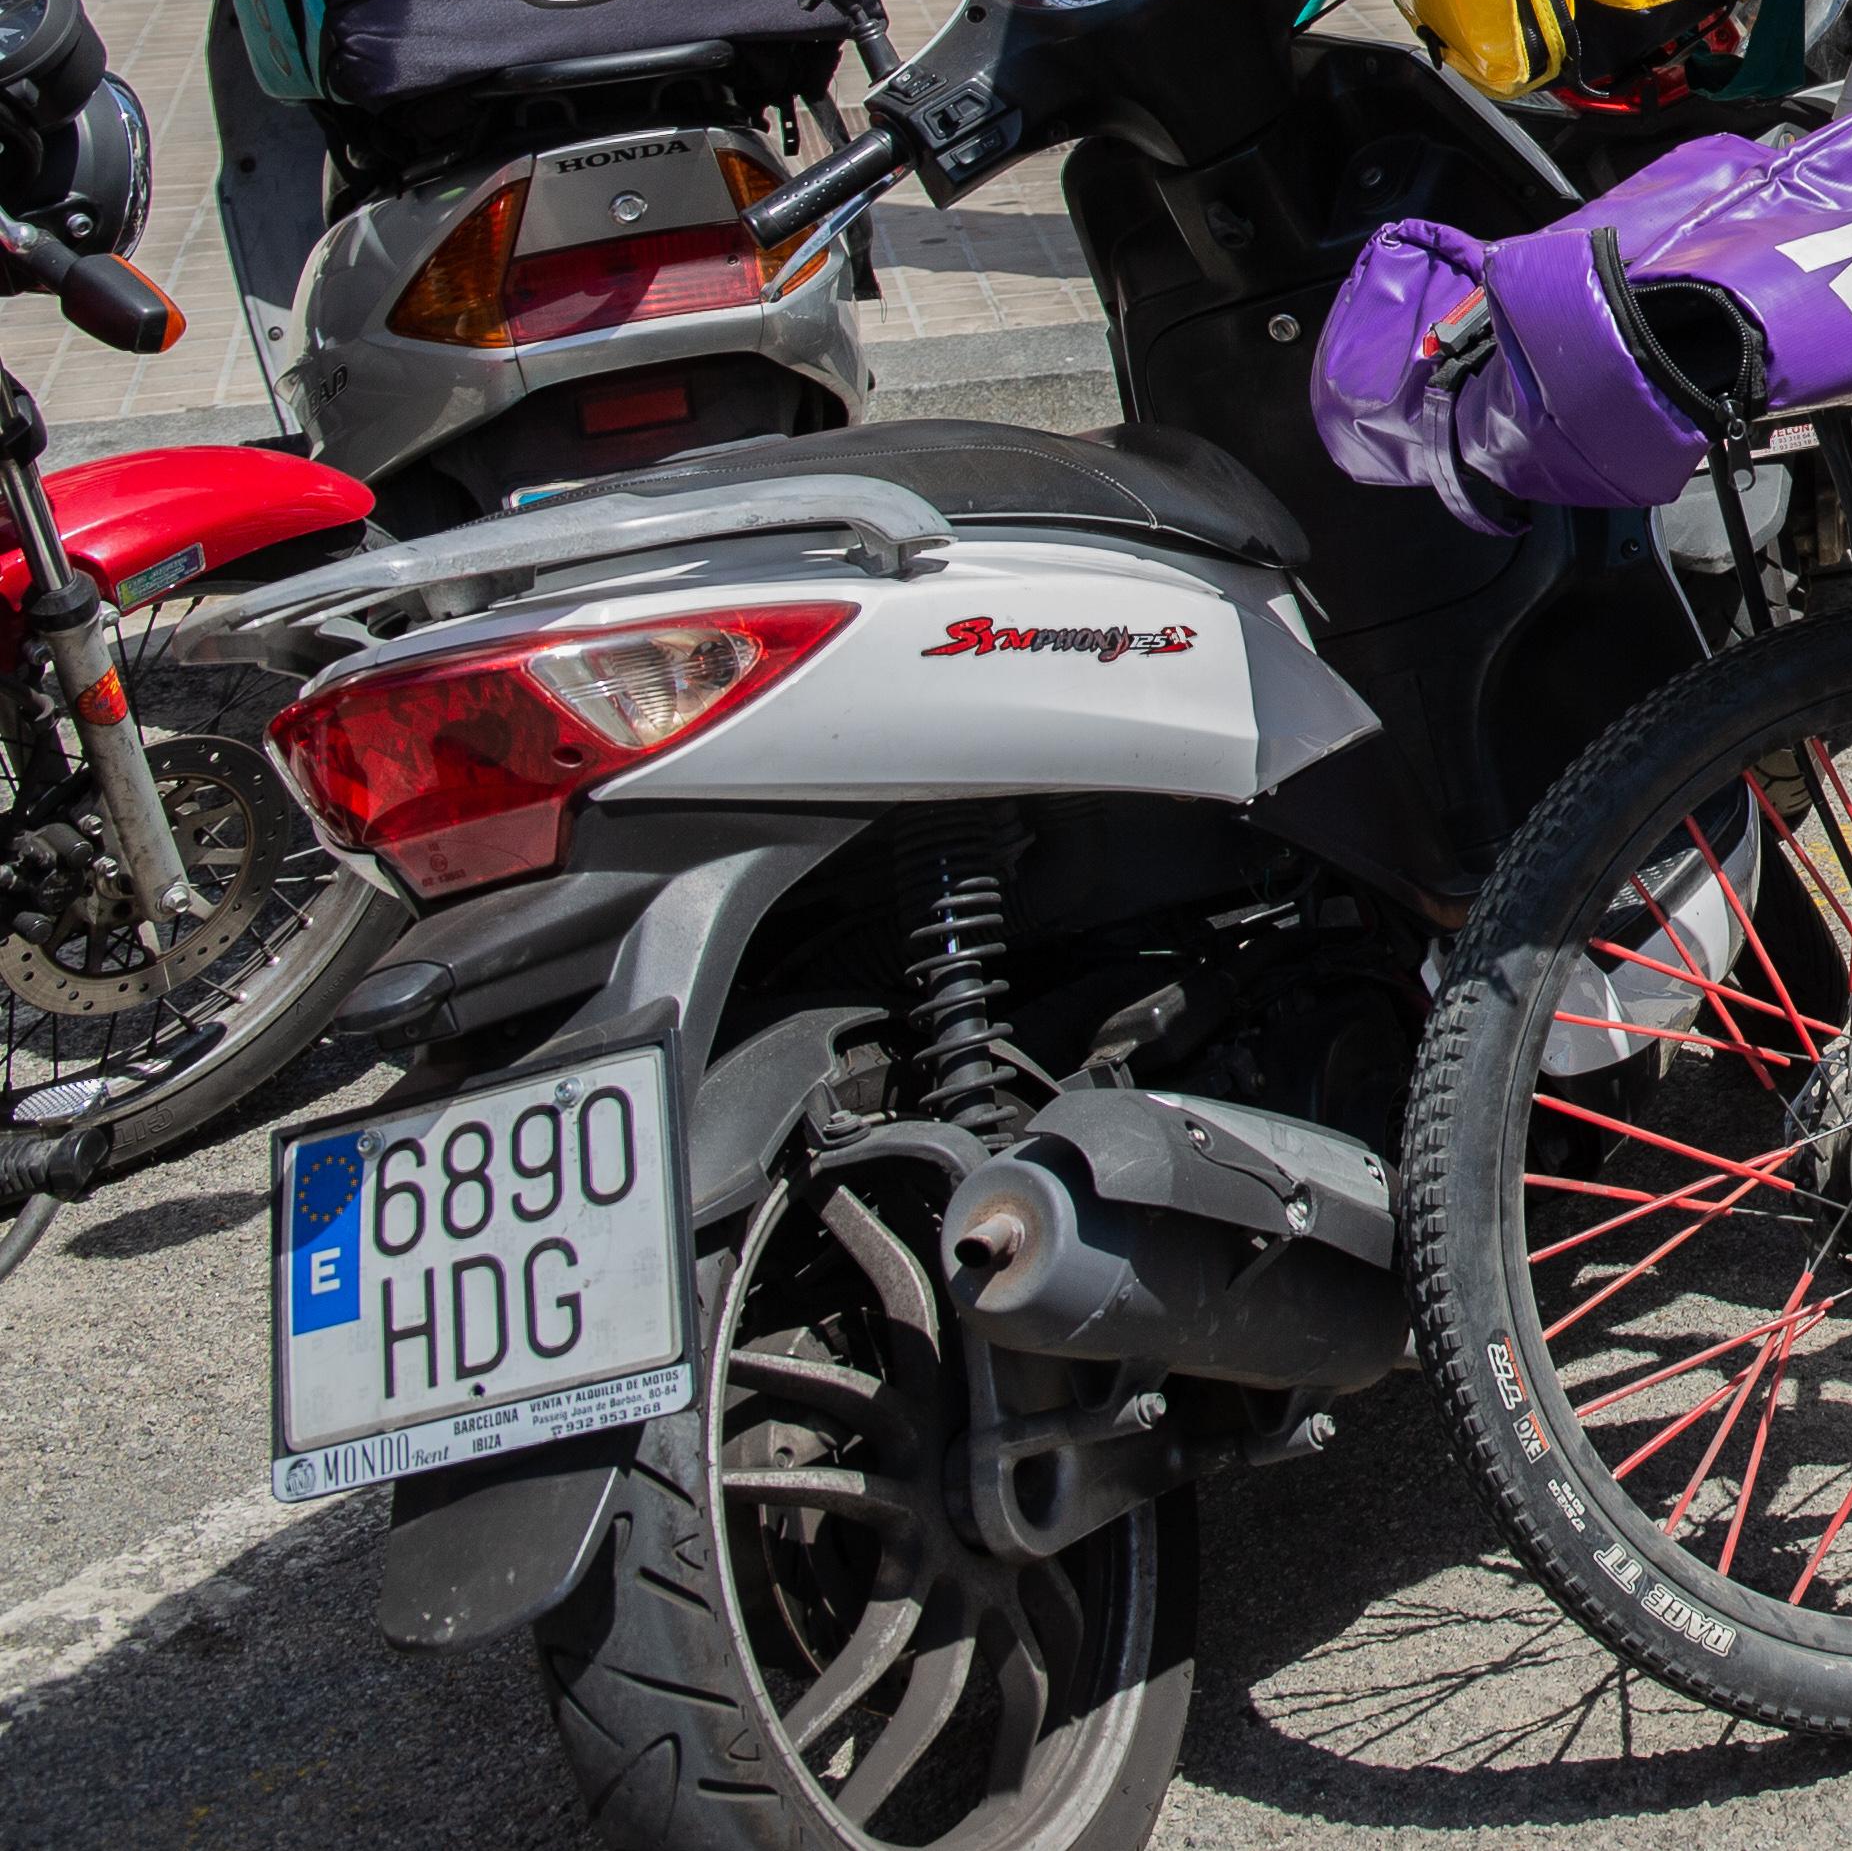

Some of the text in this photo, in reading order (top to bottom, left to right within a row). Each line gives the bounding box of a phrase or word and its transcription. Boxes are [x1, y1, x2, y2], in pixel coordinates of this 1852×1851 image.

[556, 138, 692, 175] HONDA
[1130, 633, 1170, 650] 125
[111, 1100, 175, 1151] CIT
[373, 1085, 638, 1258] 6890
[310, 1247, 341, 1295] E
[381, 1242, 582, 1400] HDG
[530, 1395, 565, 1413] VENTA
[576, 1383, 622, 1402] ALQUILER
[626, 1378, 638, 1391] DE
[642, 1369, 679, 1387] MOTOS
[453, 1408, 520, 1436] BARCELONA
[532, 1411, 568, 1426] Passeig
[571, 1402, 593, 1417] Joan
[595, 1400, 606, 1411] de
[566, 1402, 661, 1432] 932 953 268
[324, 1432, 450, 1489] MONDO Rent
[472, 1435, 502, 1455] IBIZA
[1517, 1419, 1544, 1462] EXO
[1593, 1542, 1737, 1657] RACE TT
